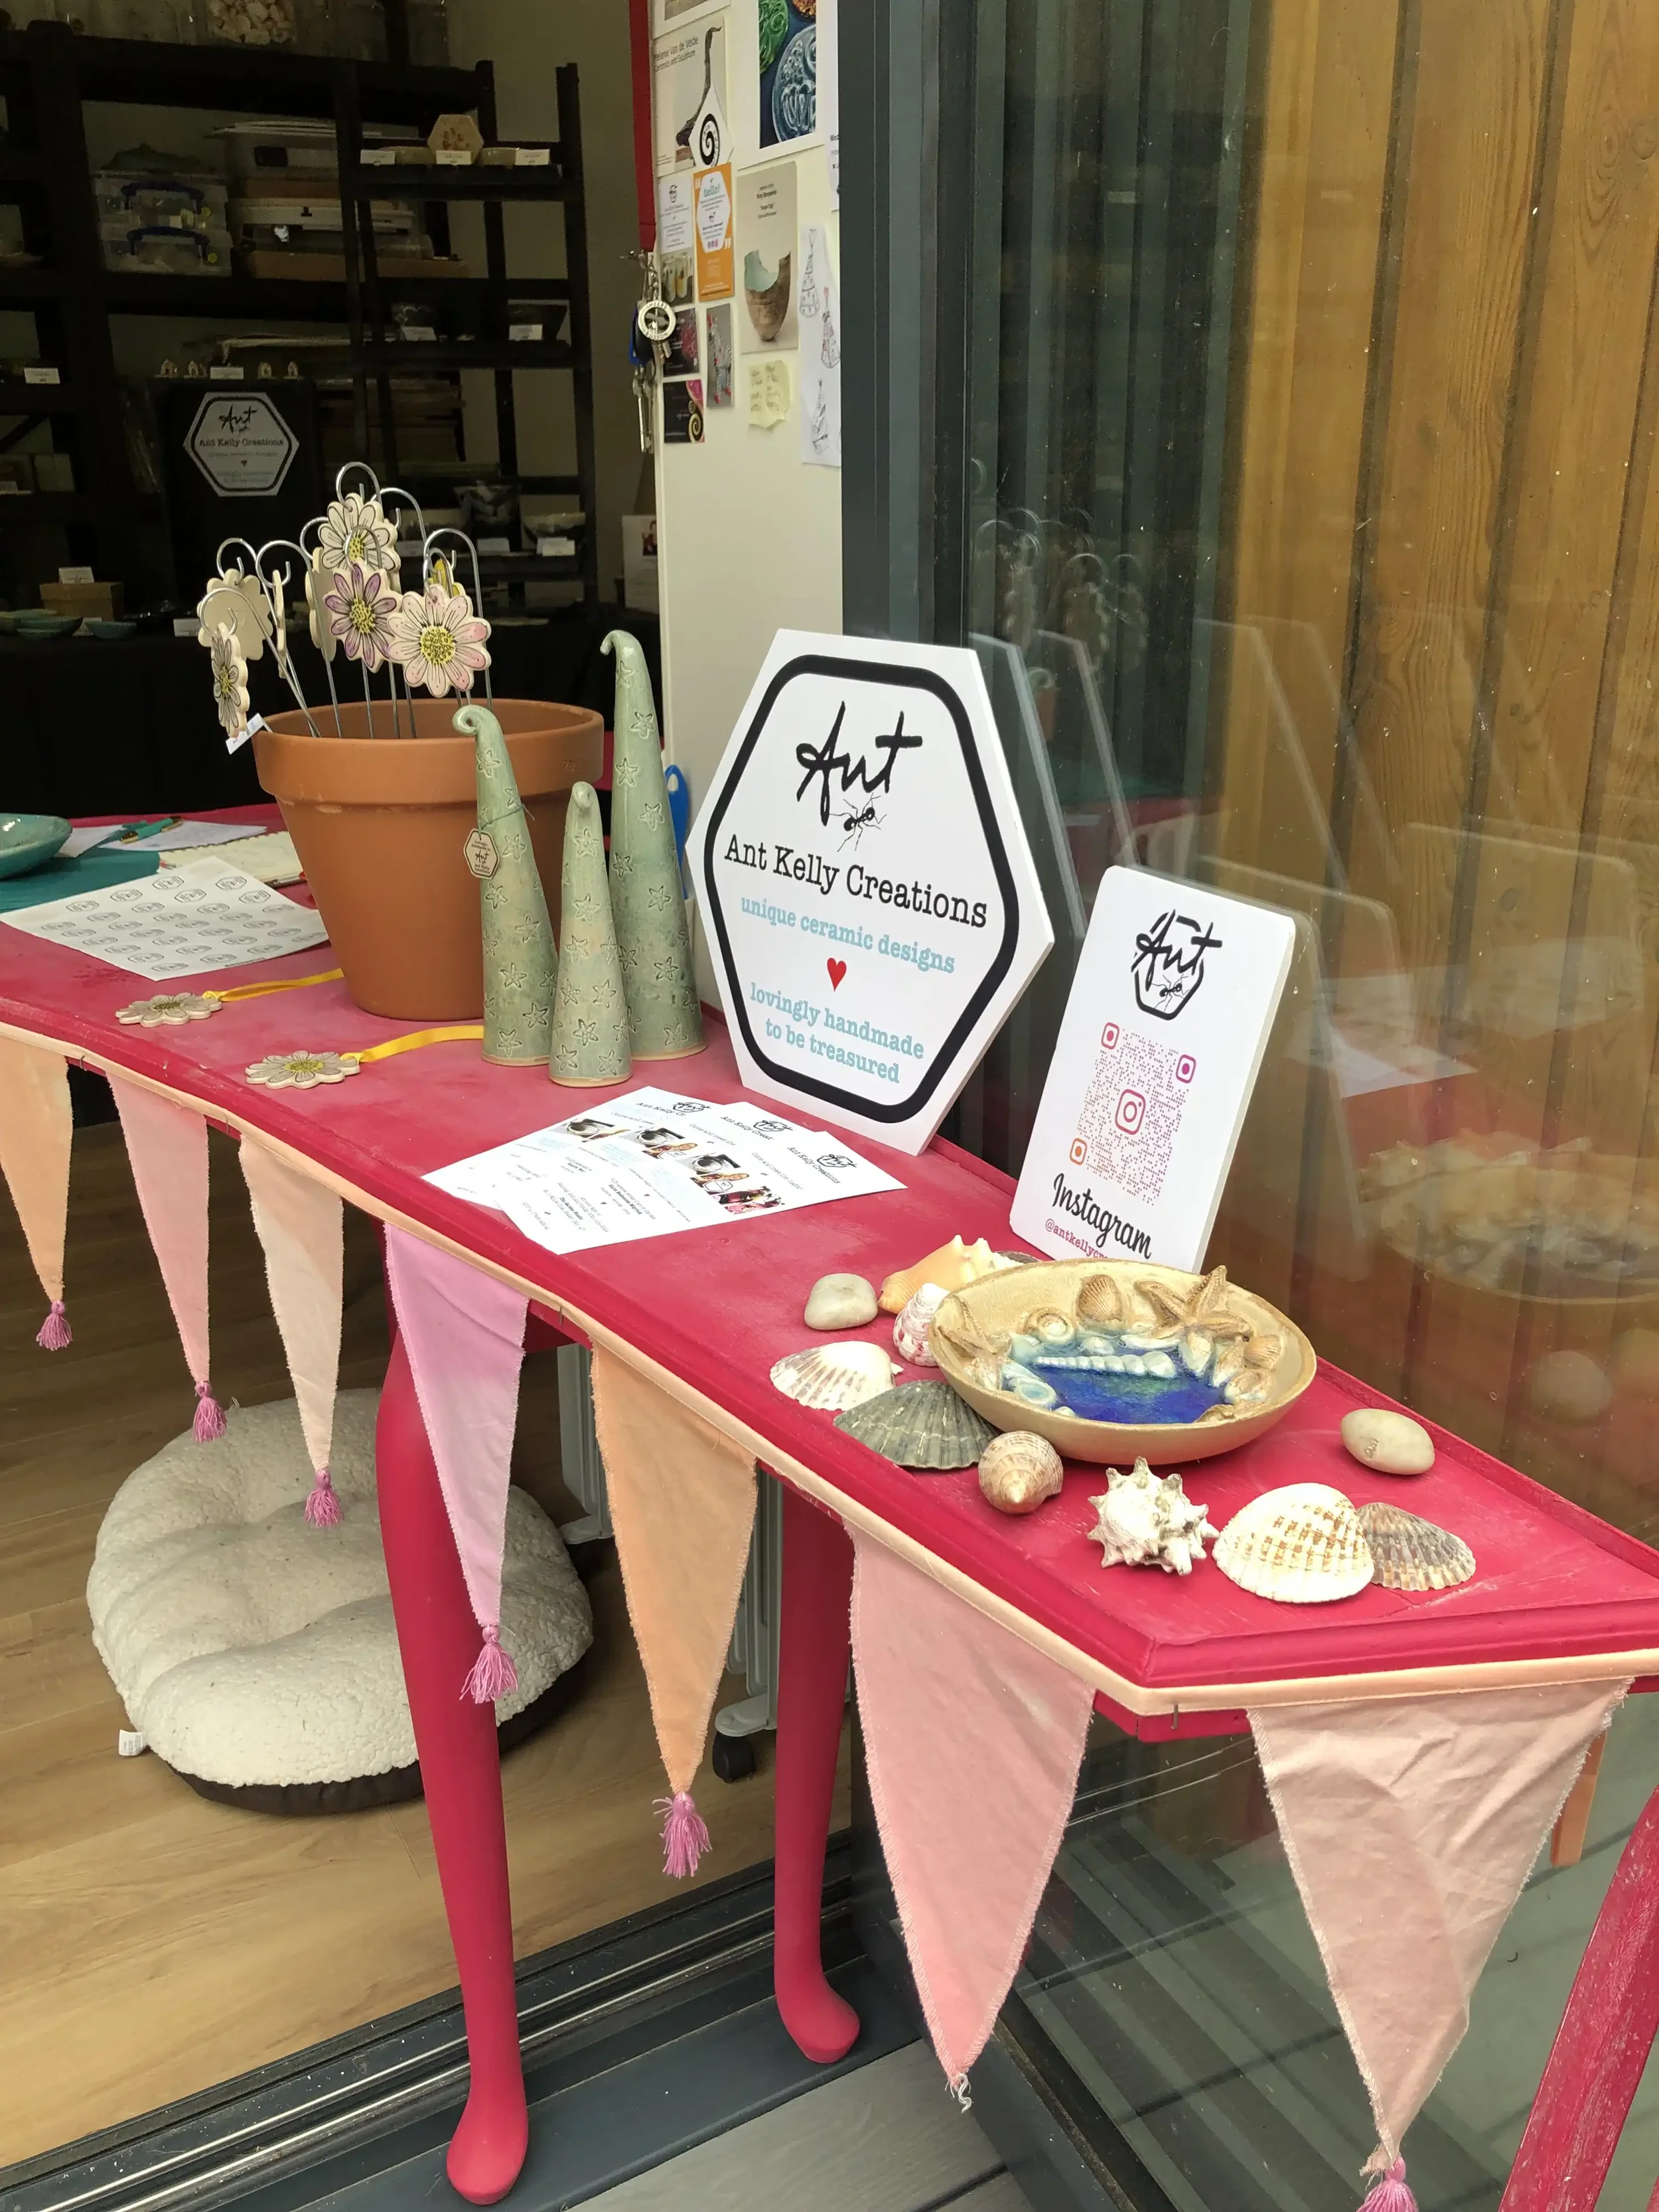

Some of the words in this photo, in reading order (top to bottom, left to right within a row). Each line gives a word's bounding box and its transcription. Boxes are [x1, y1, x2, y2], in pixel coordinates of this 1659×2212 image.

[796, 701, 922, 826] Ant
[724, 834, 767, 871] Ant
[773, 845, 839, 895] Kelly
[847, 864, 987, 928] Creations
[741, 897, 796, 926] unique
[800, 915, 873, 950] ceramic
[877, 934, 955, 974] designs
[1131, 909, 1222, 992] Ant
[750, 982, 821, 1027] lovingly
[823, 1007, 924, 1059] handmade
[765, 1018, 782, 1039] to
[786, 1024, 805, 1049] be
[809, 1034, 900, 1084] treasured
[1052, 1173, 1151, 1260] Instagram
